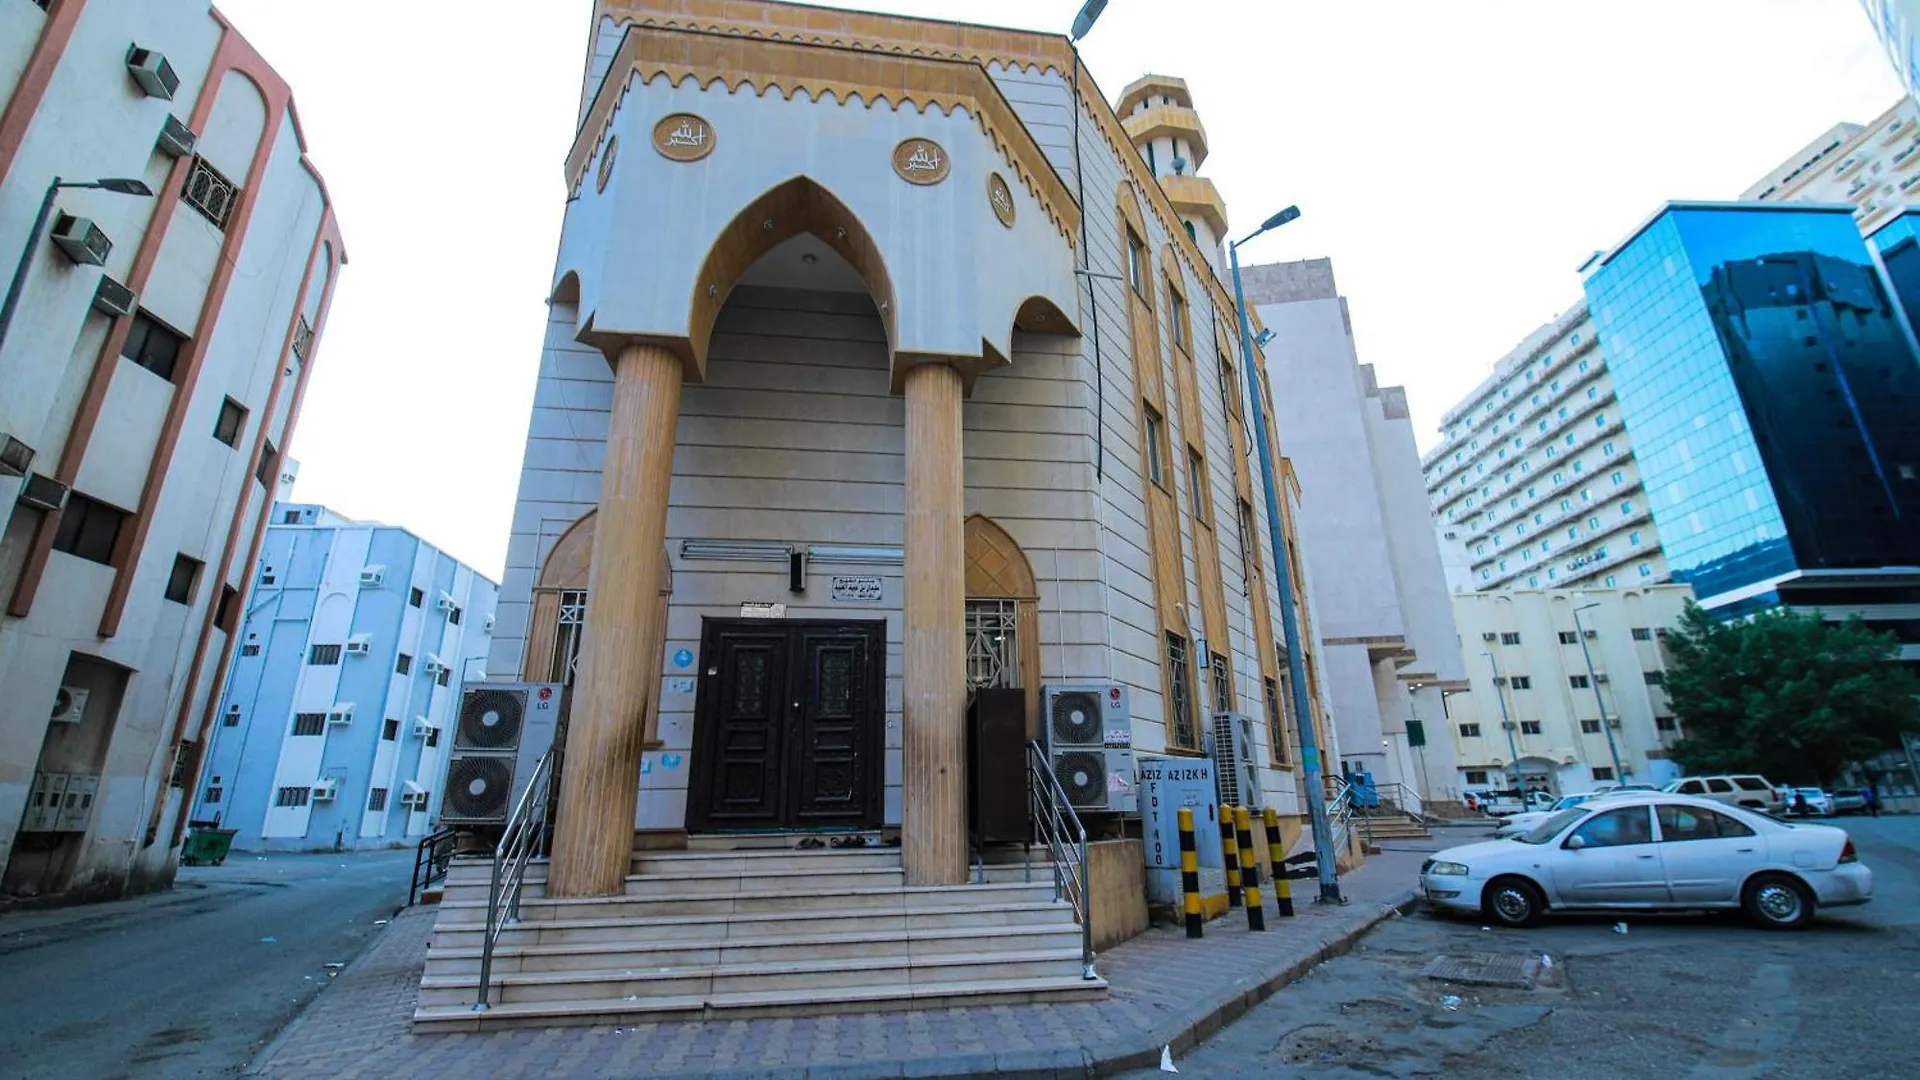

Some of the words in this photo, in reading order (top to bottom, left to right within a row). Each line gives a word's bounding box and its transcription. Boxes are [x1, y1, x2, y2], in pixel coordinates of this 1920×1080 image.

[537, 702, 549, 710] LG
[1110, 701, 1121, 709] LG
[1140, 769, 1162, 780] AZIZ
